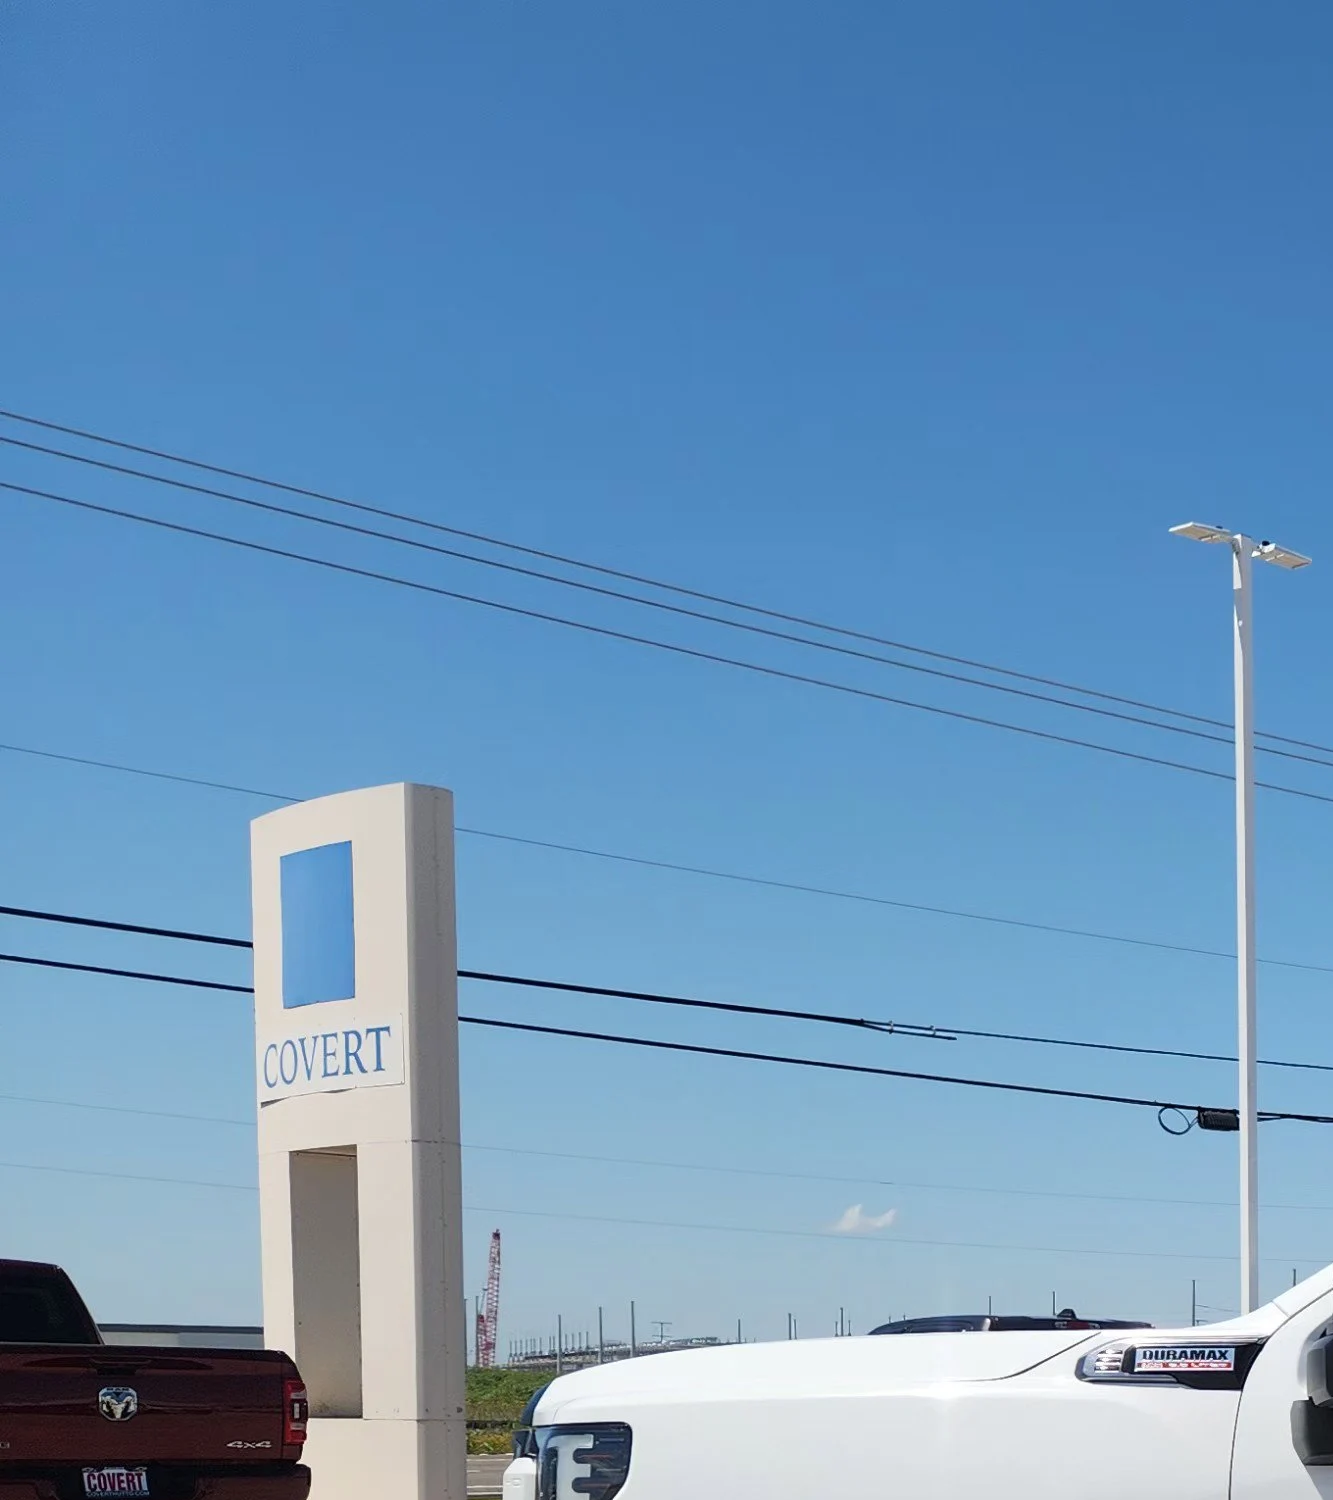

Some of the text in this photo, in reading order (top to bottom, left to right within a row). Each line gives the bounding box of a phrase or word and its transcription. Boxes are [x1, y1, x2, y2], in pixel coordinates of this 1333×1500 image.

[263, 1026, 392, 1089] COVERT
[1142, 1349, 1230, 1360] DURAMAX
[226, 1440, 272, 1450] 4x4
[86, 1472, 144, 1492] COVERT
